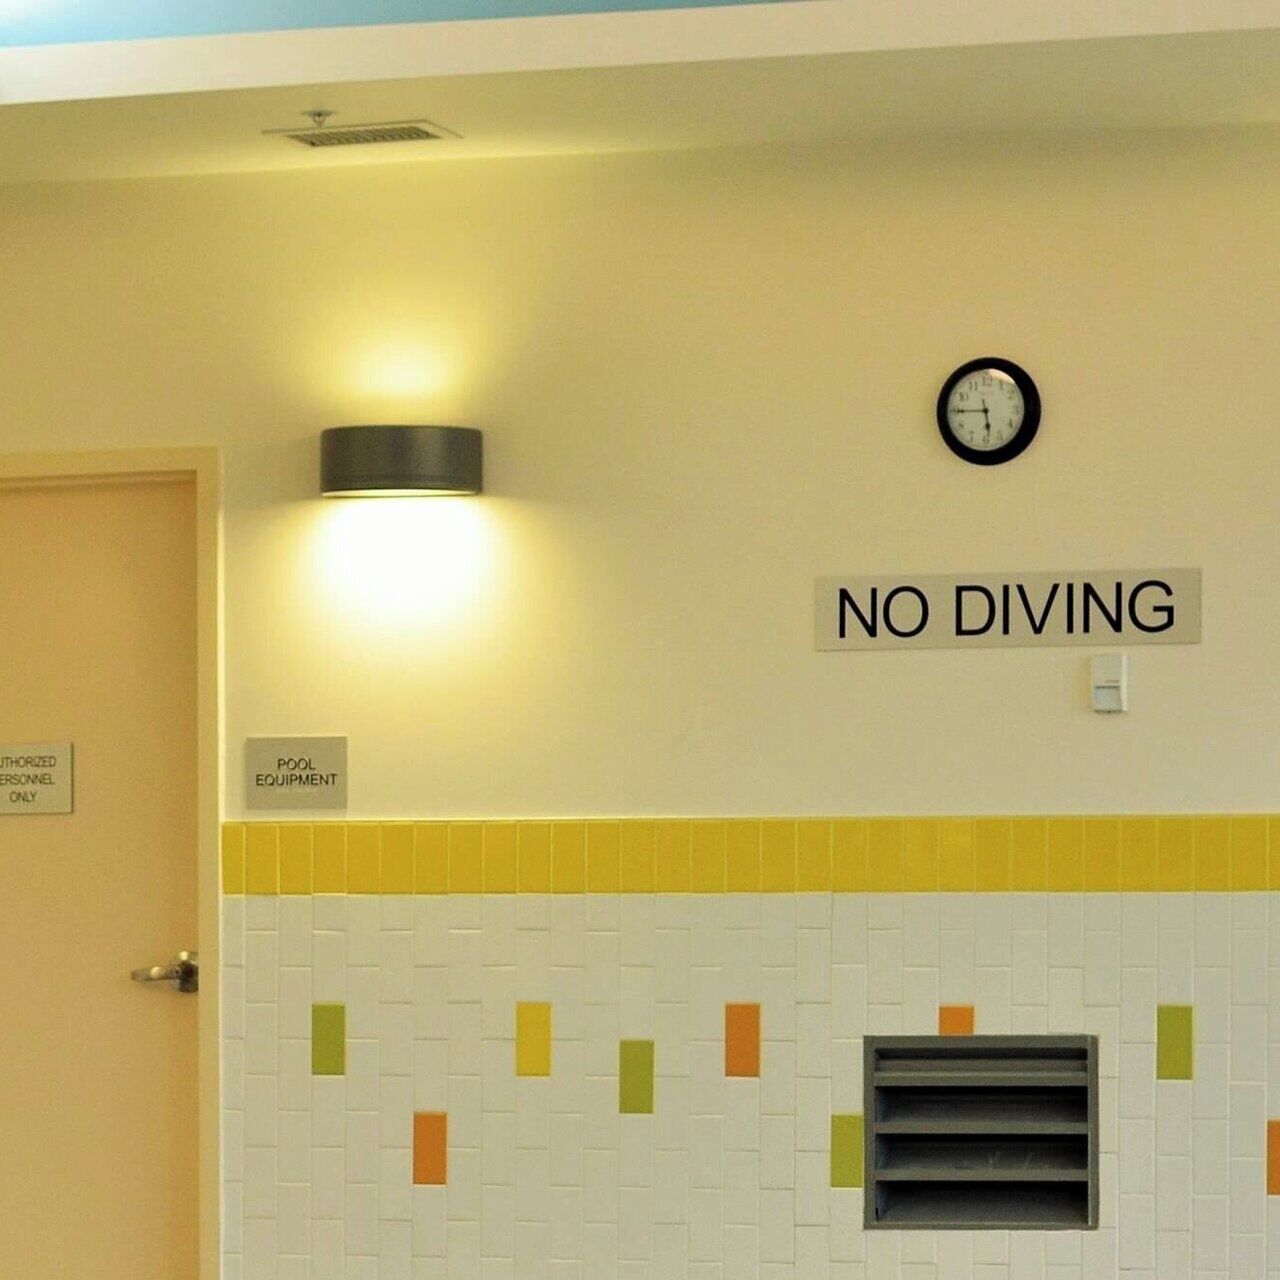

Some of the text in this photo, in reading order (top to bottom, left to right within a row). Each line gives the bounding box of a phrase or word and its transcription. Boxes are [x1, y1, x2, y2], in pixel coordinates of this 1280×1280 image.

[839, 580, 1174, 638] NO DIVING
[278, 758, 315, 770] POOL
[256, 774, 337, 786] EQUIPMENT
[10, 791, 36, 803] ONLY
